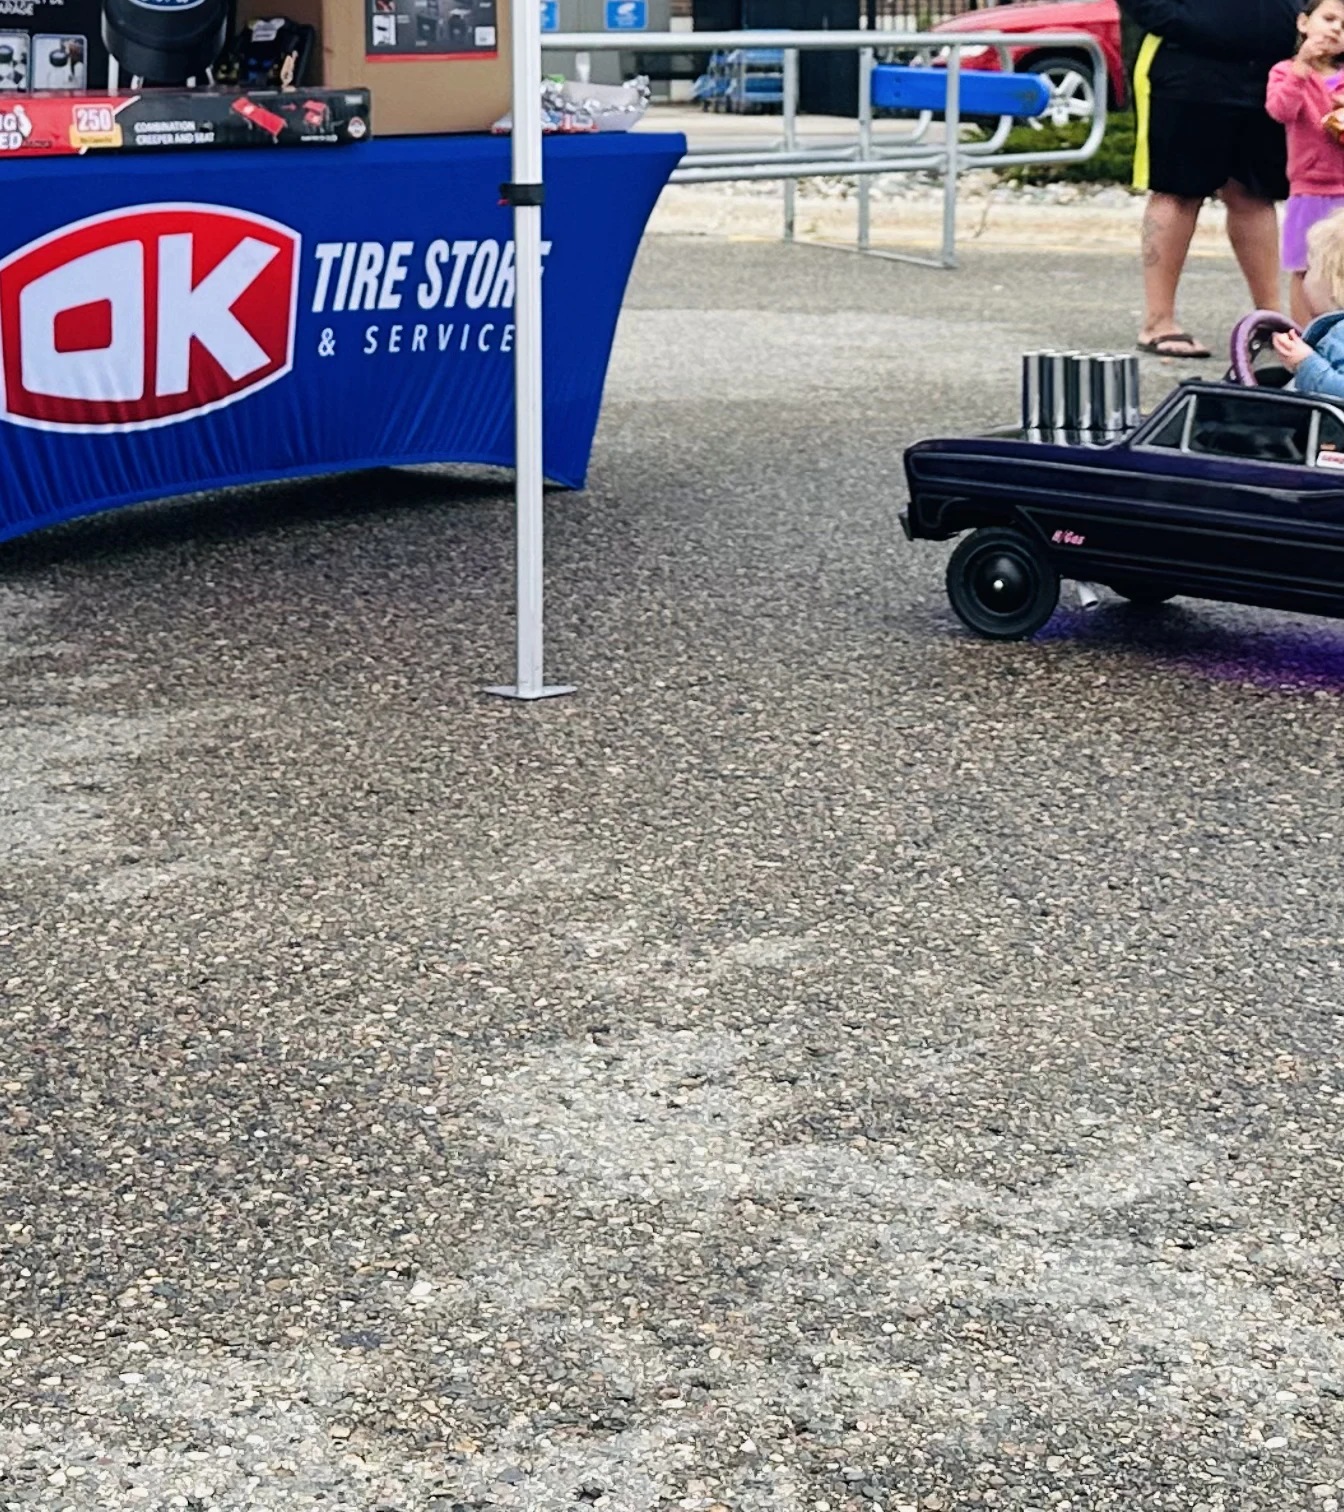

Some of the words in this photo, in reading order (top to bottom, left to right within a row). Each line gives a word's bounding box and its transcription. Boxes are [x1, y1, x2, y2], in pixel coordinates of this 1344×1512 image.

[76, 108, 112, 131] 250
[174, 132, 194, 145] AND
[311, 240, 415, 313] TIRE
[417, 238, 553, 311] STOR
[19, 232, 282, 402] OK
[317, 328, 337, 357] &
[363, 323, 516, 355] SERVICE
